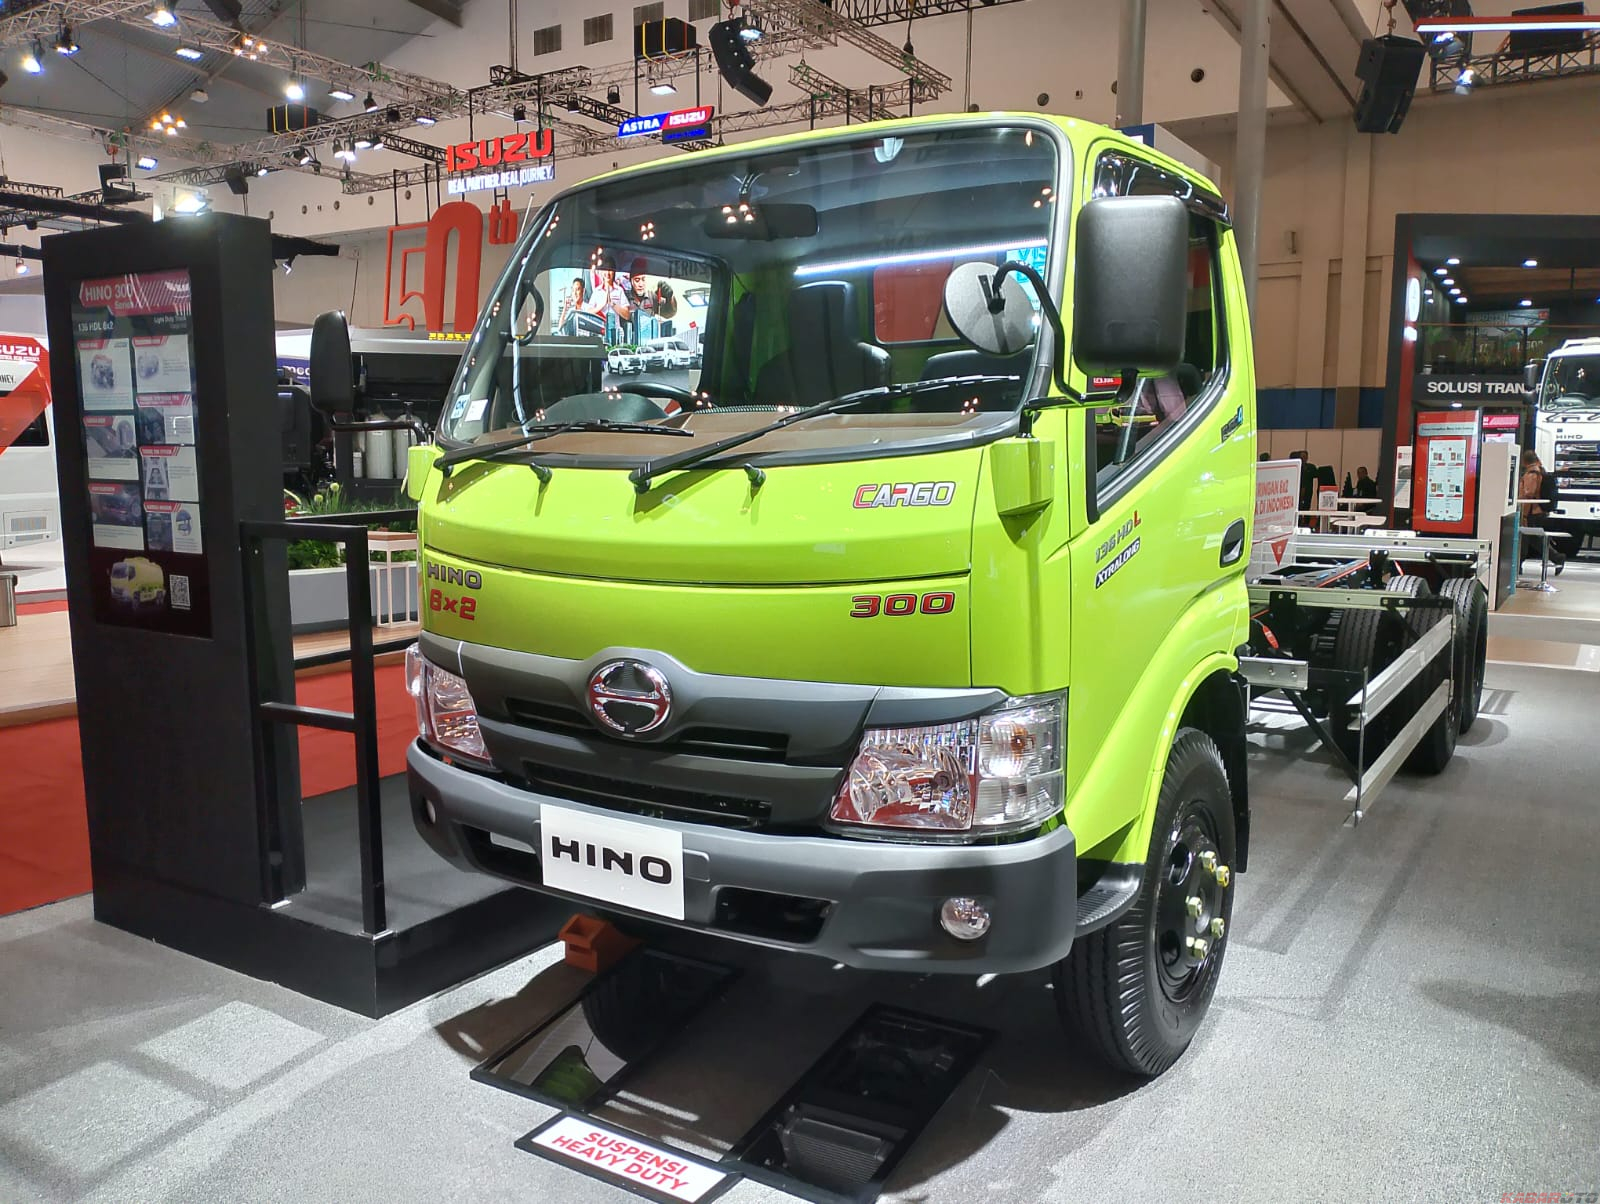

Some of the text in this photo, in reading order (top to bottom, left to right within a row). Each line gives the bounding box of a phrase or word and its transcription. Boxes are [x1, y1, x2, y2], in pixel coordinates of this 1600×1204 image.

[623, 111, 706, 133] ASTRA ISUZU
[447, 128, 552, 172] ISUZU
[448, 178, 466, 194] REAL
[501, 170, 519, 186] REAL
[85, 283, 133, 302] HINO 300
[1427, 382, 1482, 394] SOLUSI
[853, 481, 956, 508] CARGO
[1096, 510, 1141, 564] 136 HDL
[427, 561, 482, 590] HINO
[1096, 539, 1140, 588] XTRALONG
[850, 592, 955, 618] 300
[551, 836, 672, 885] HINO
[552, 1135, 690, 1191] HEAVY DUTY
[584, 1131, 689, 1176] SUSPENSI
